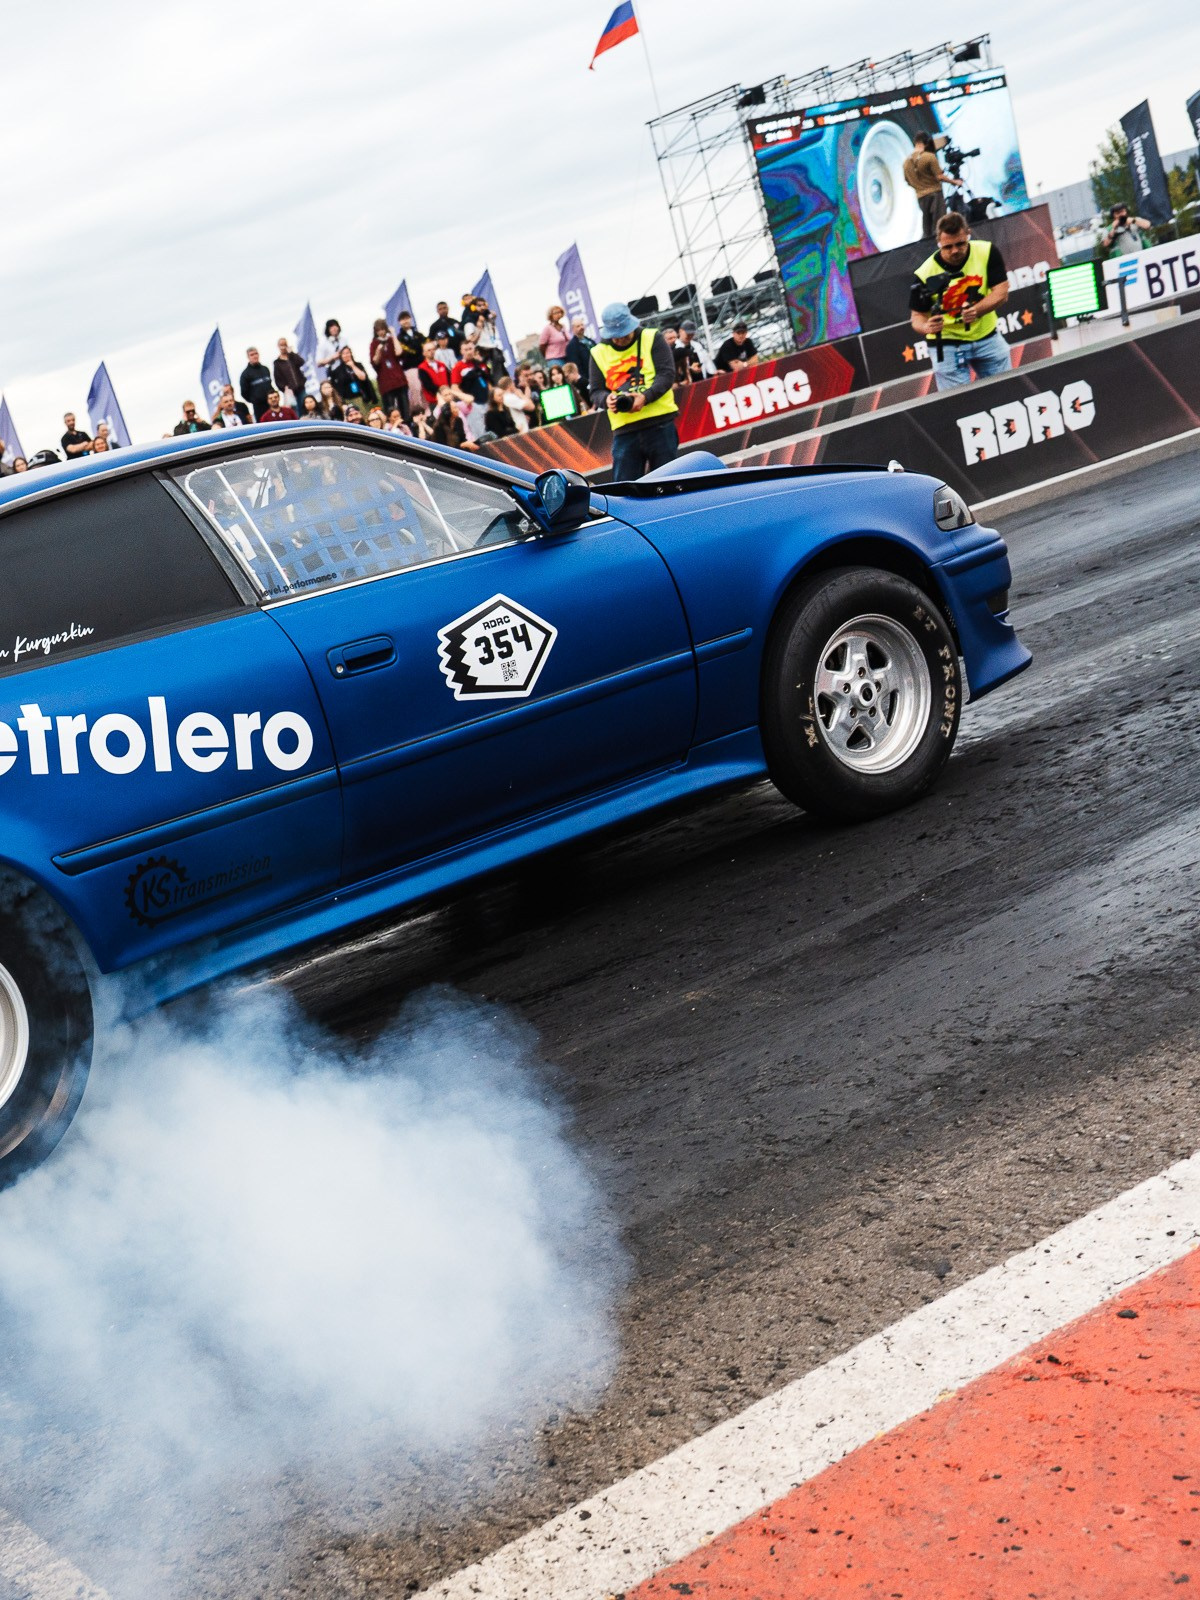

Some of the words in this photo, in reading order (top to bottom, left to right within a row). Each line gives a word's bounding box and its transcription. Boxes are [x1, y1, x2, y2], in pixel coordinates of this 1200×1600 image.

[1145, 250, 1200, 299] ВТБ
[707, 369, 812, 428] RDRC
[956, 379, 1096, 466] RDRC
[13, 622, 95, 663] Kurguzkin
[474, 623, 533, 665] 354
[482, 615, 511, 630] RDRC
